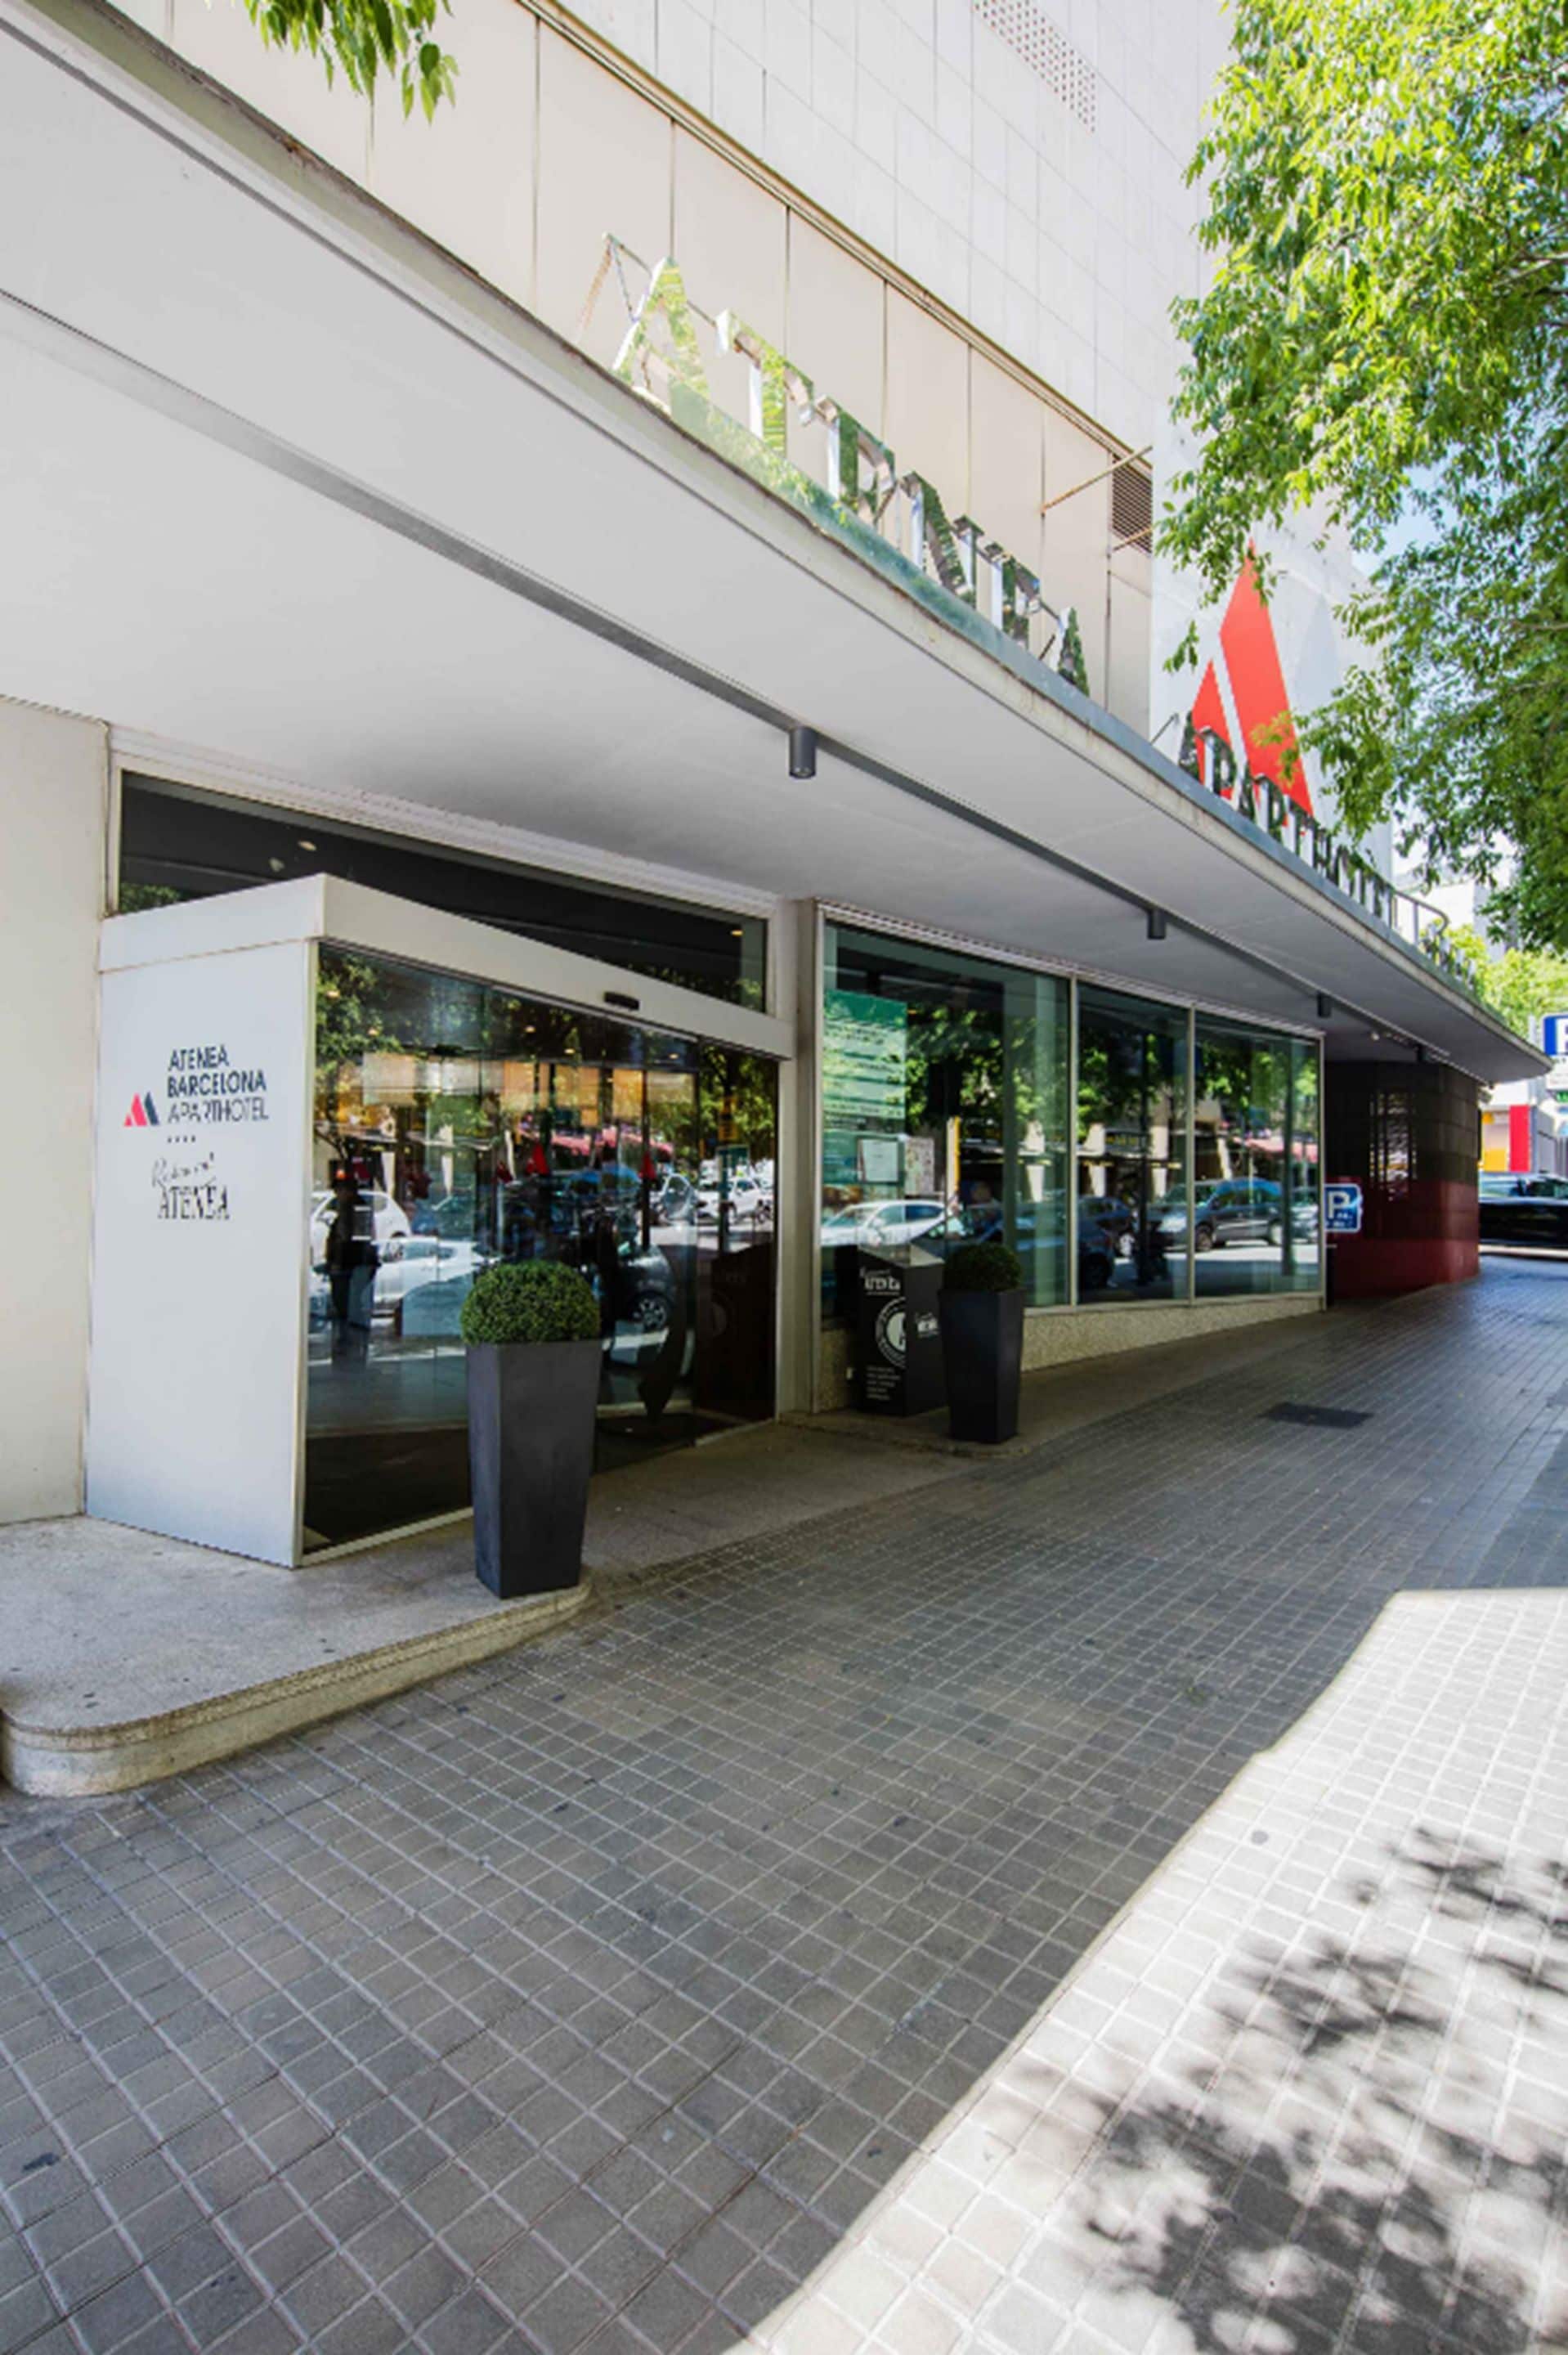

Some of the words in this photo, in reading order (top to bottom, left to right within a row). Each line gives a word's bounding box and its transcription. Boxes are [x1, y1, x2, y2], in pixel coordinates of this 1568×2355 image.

[168, 1043, 230, 1072] ATENEA
[167, 1070, 267, 1098] BARCELONA
[167, 1097, 269, 1124] APARTHOTEL
[157, 1185, 231, 1220] ATENEA
[1328, 1191, 1350, 1219] P
